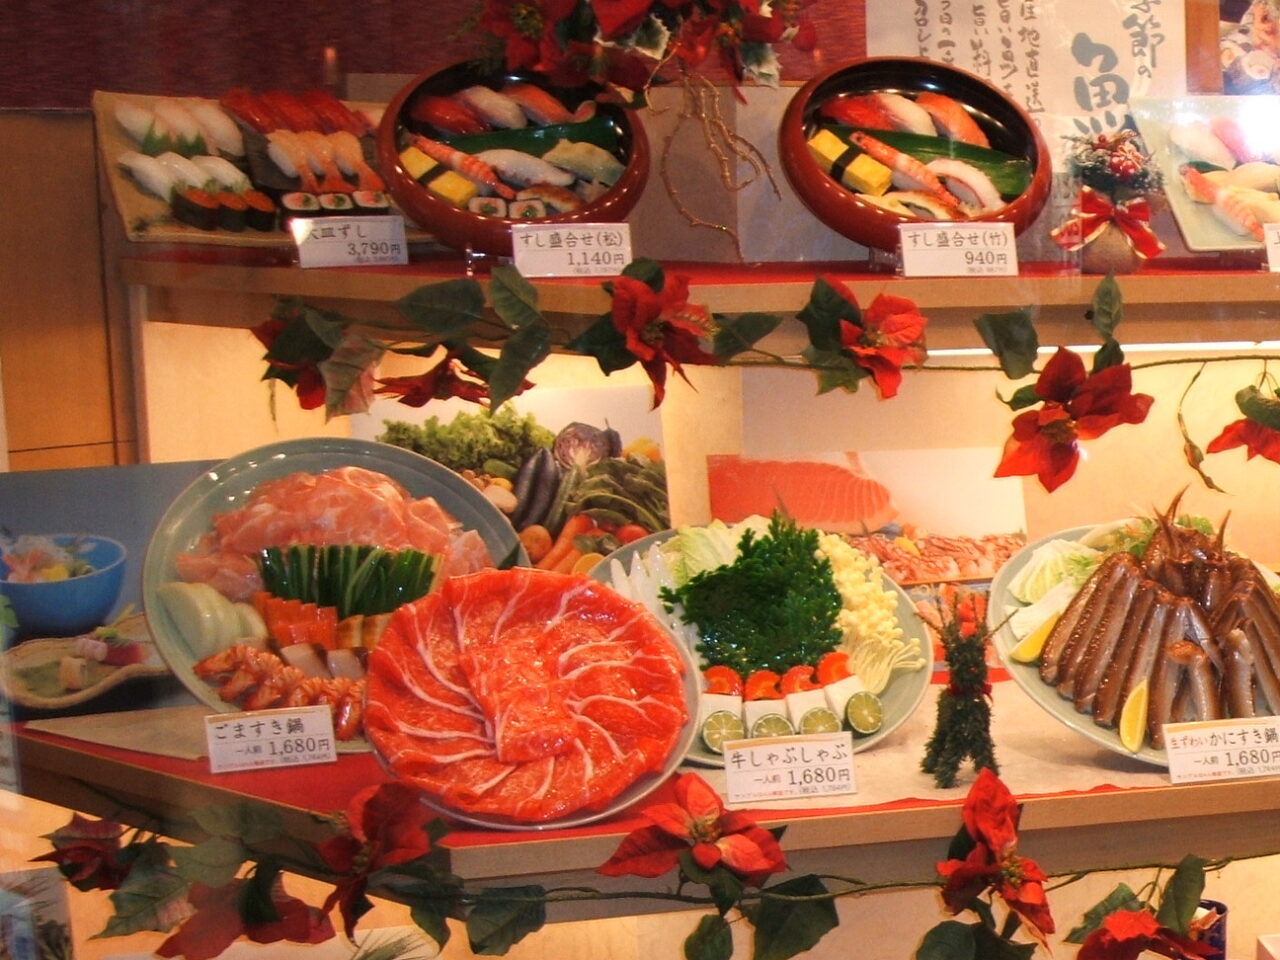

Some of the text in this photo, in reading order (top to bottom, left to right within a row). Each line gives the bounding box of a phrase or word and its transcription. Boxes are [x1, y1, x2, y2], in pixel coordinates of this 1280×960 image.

[567, 251, 625, 267] 1,140円
[964, 250, 1009, 265] 940円
[268, 737, 331, 756] 1,680円
[731, 743, 849, 769] 牛しゃぶしゃぶ
[787, 766, 851, 786] 1,680円
